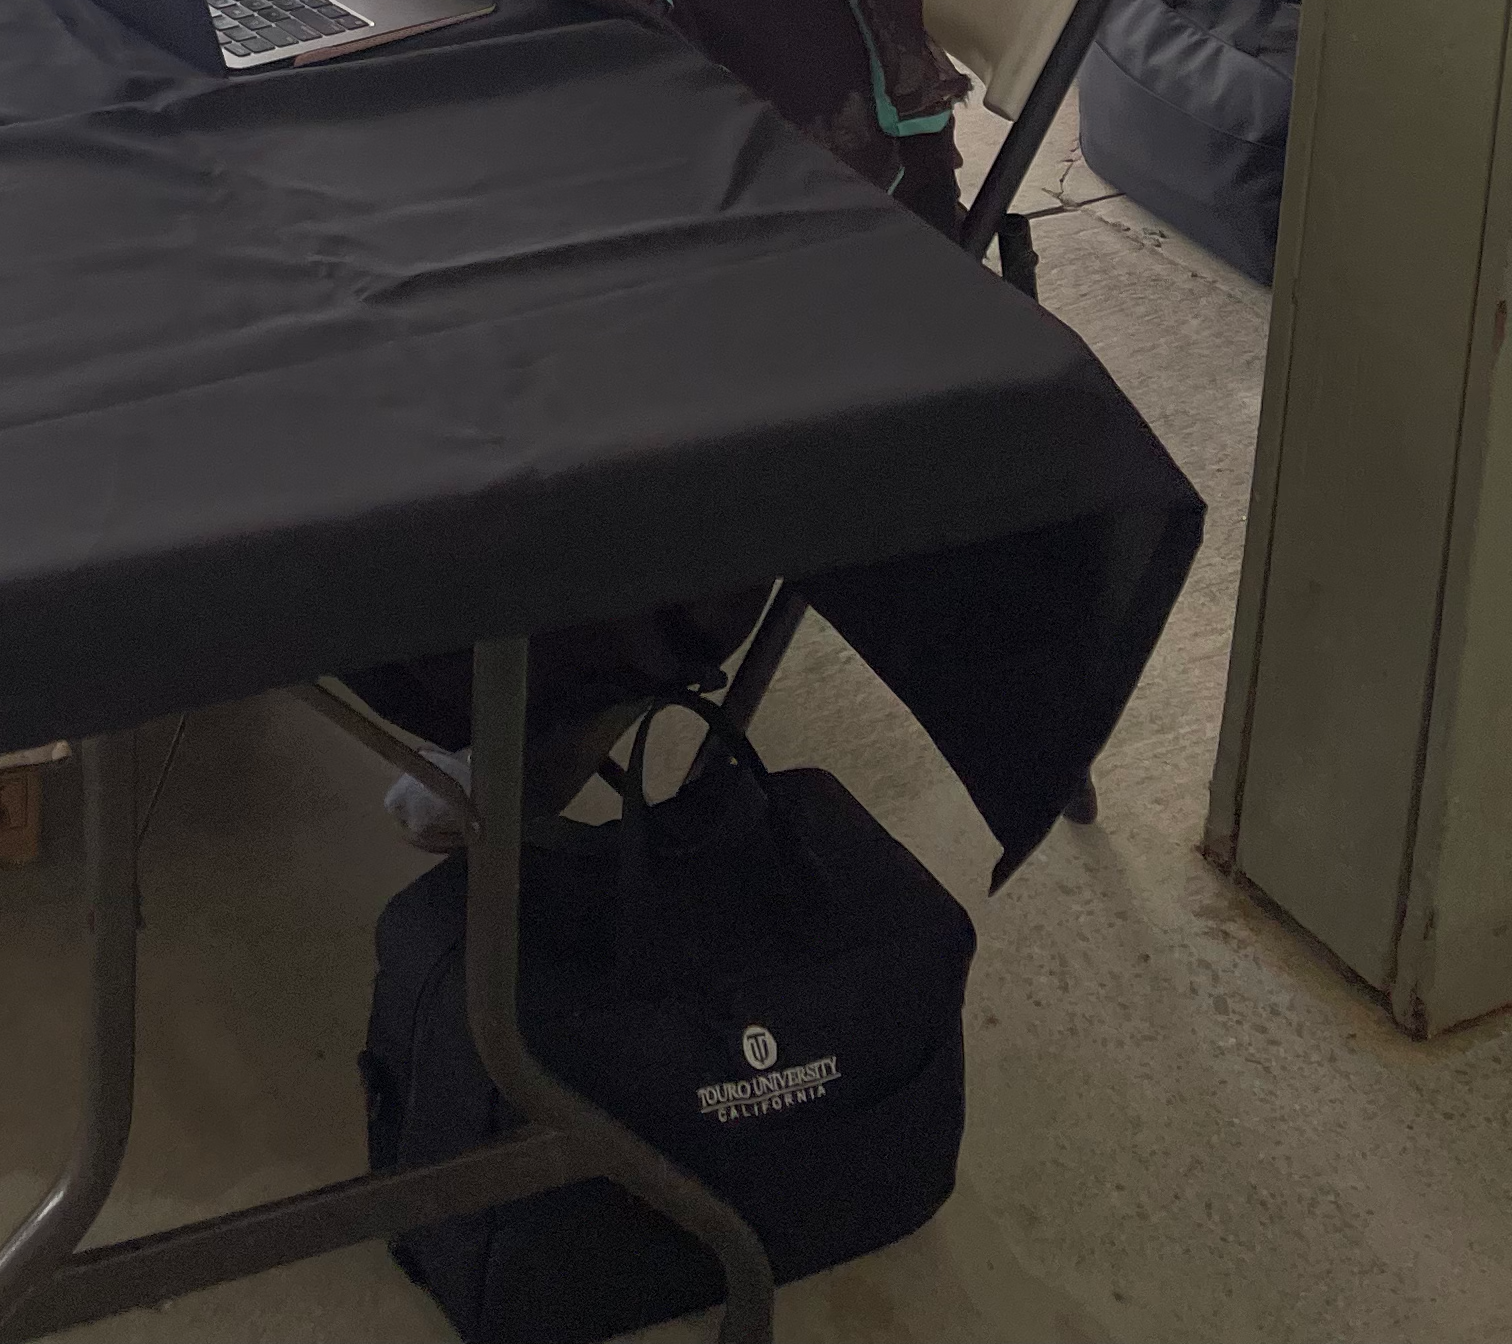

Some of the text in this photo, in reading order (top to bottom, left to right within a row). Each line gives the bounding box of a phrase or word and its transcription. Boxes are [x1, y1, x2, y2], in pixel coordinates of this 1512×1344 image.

[696, 1056, 837, 1107] TOURO UNIVERSITY
[718, 1086, 826, 1123] CALIFORNIA
